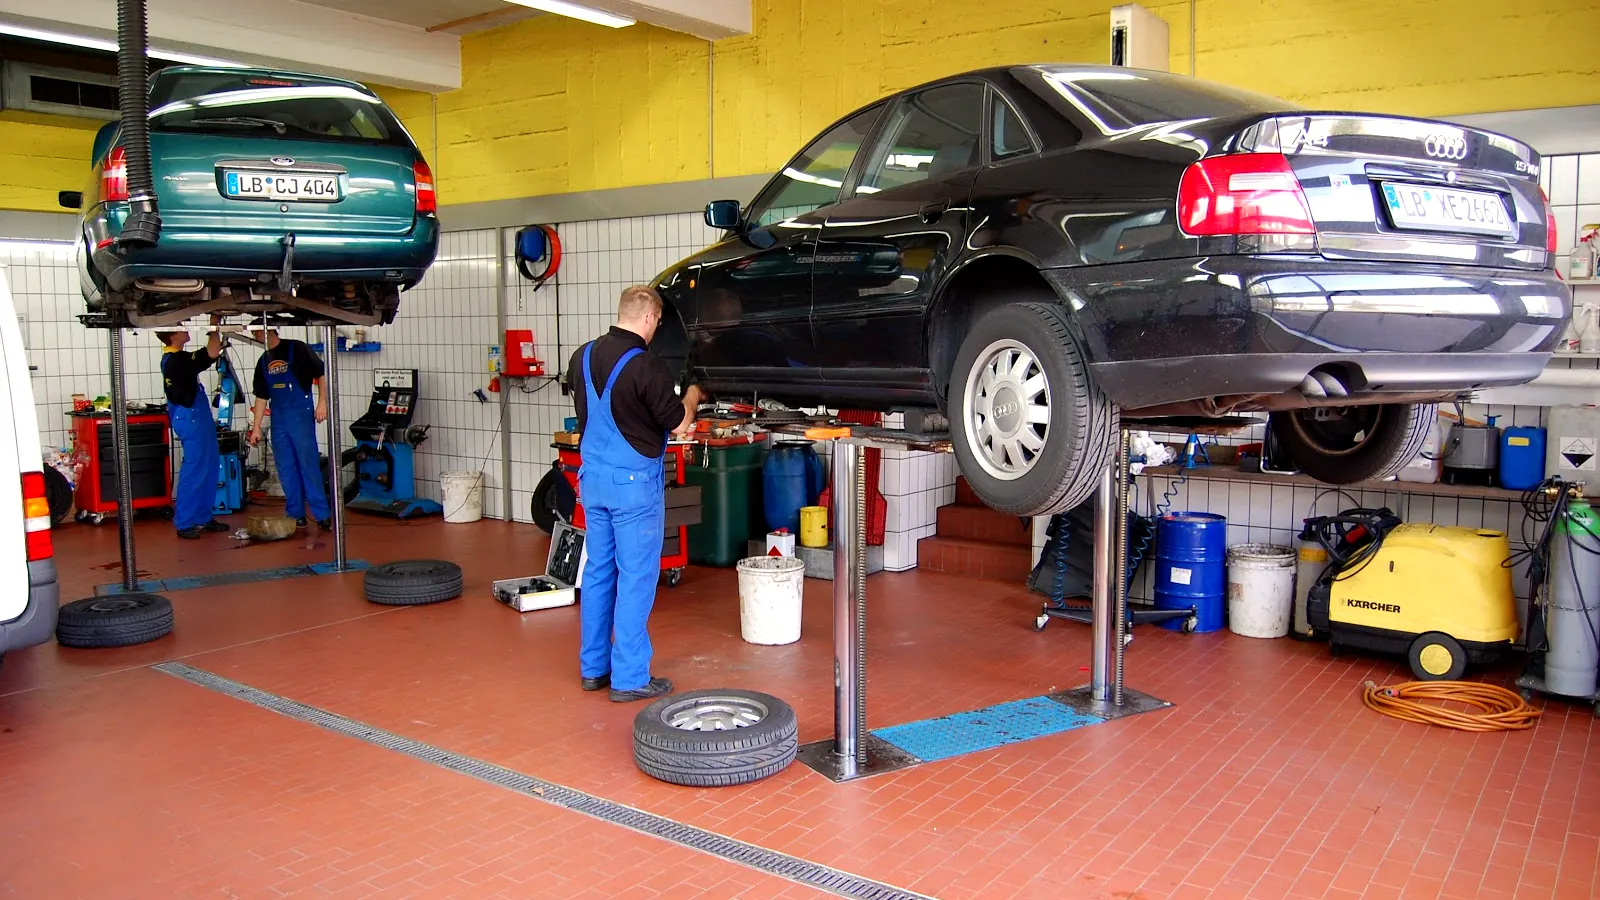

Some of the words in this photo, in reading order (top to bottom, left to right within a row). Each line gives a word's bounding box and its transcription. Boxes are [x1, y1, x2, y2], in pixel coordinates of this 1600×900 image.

[240, 176, 263, 193] LB
[275, 178, 298, 194] CJ
[303, 179, 335, 196] 404
[1398, 190, 1427, 217] LB
